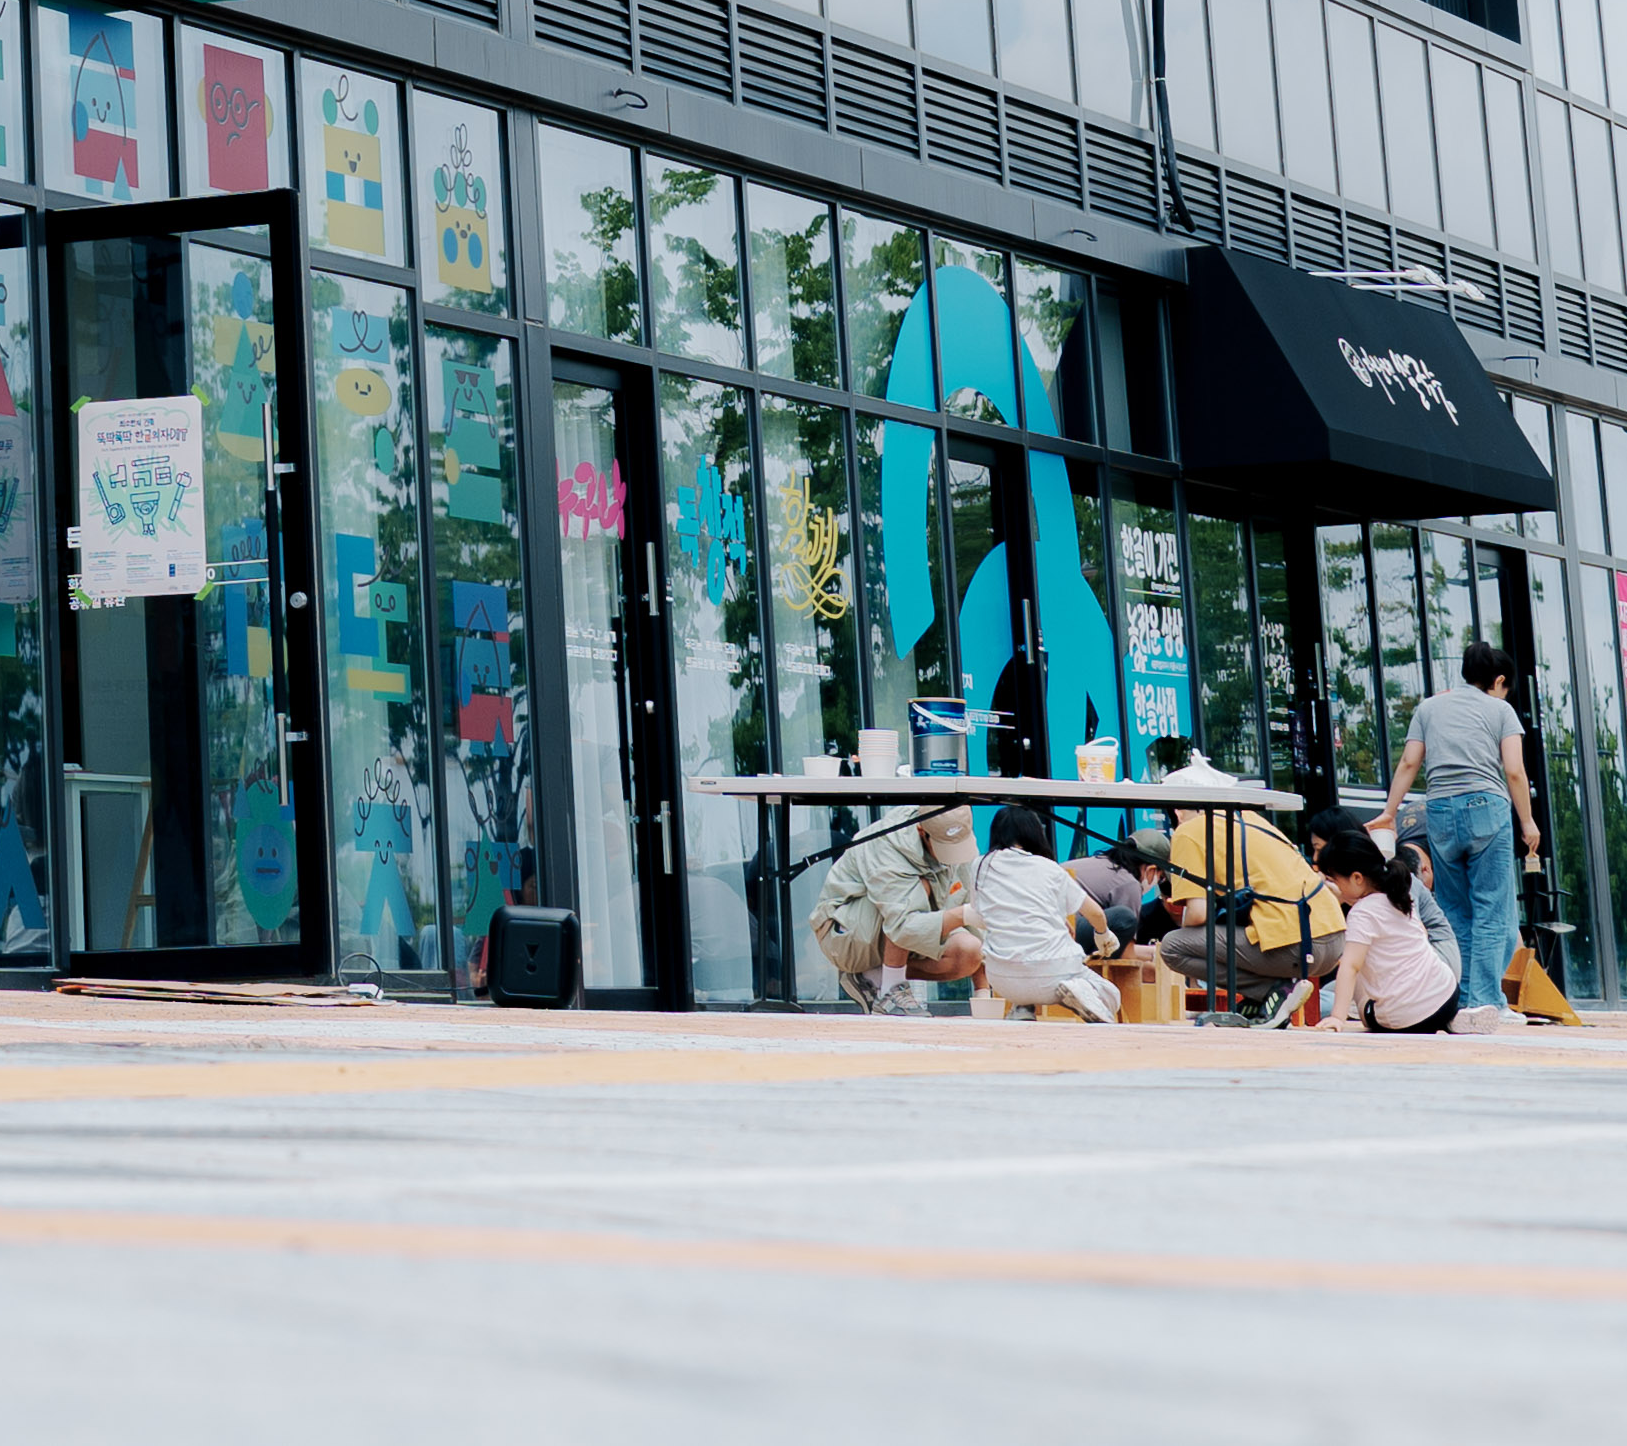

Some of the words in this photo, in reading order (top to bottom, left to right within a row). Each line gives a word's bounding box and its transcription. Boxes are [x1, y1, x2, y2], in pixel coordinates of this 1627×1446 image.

[1120, 523, 1158, 581] 한글이
[1156, 531, 1181, 585] 가진
[1161, 606, 1185, 658] 상상
[1132, 680, 1180, 739] 한글상점
